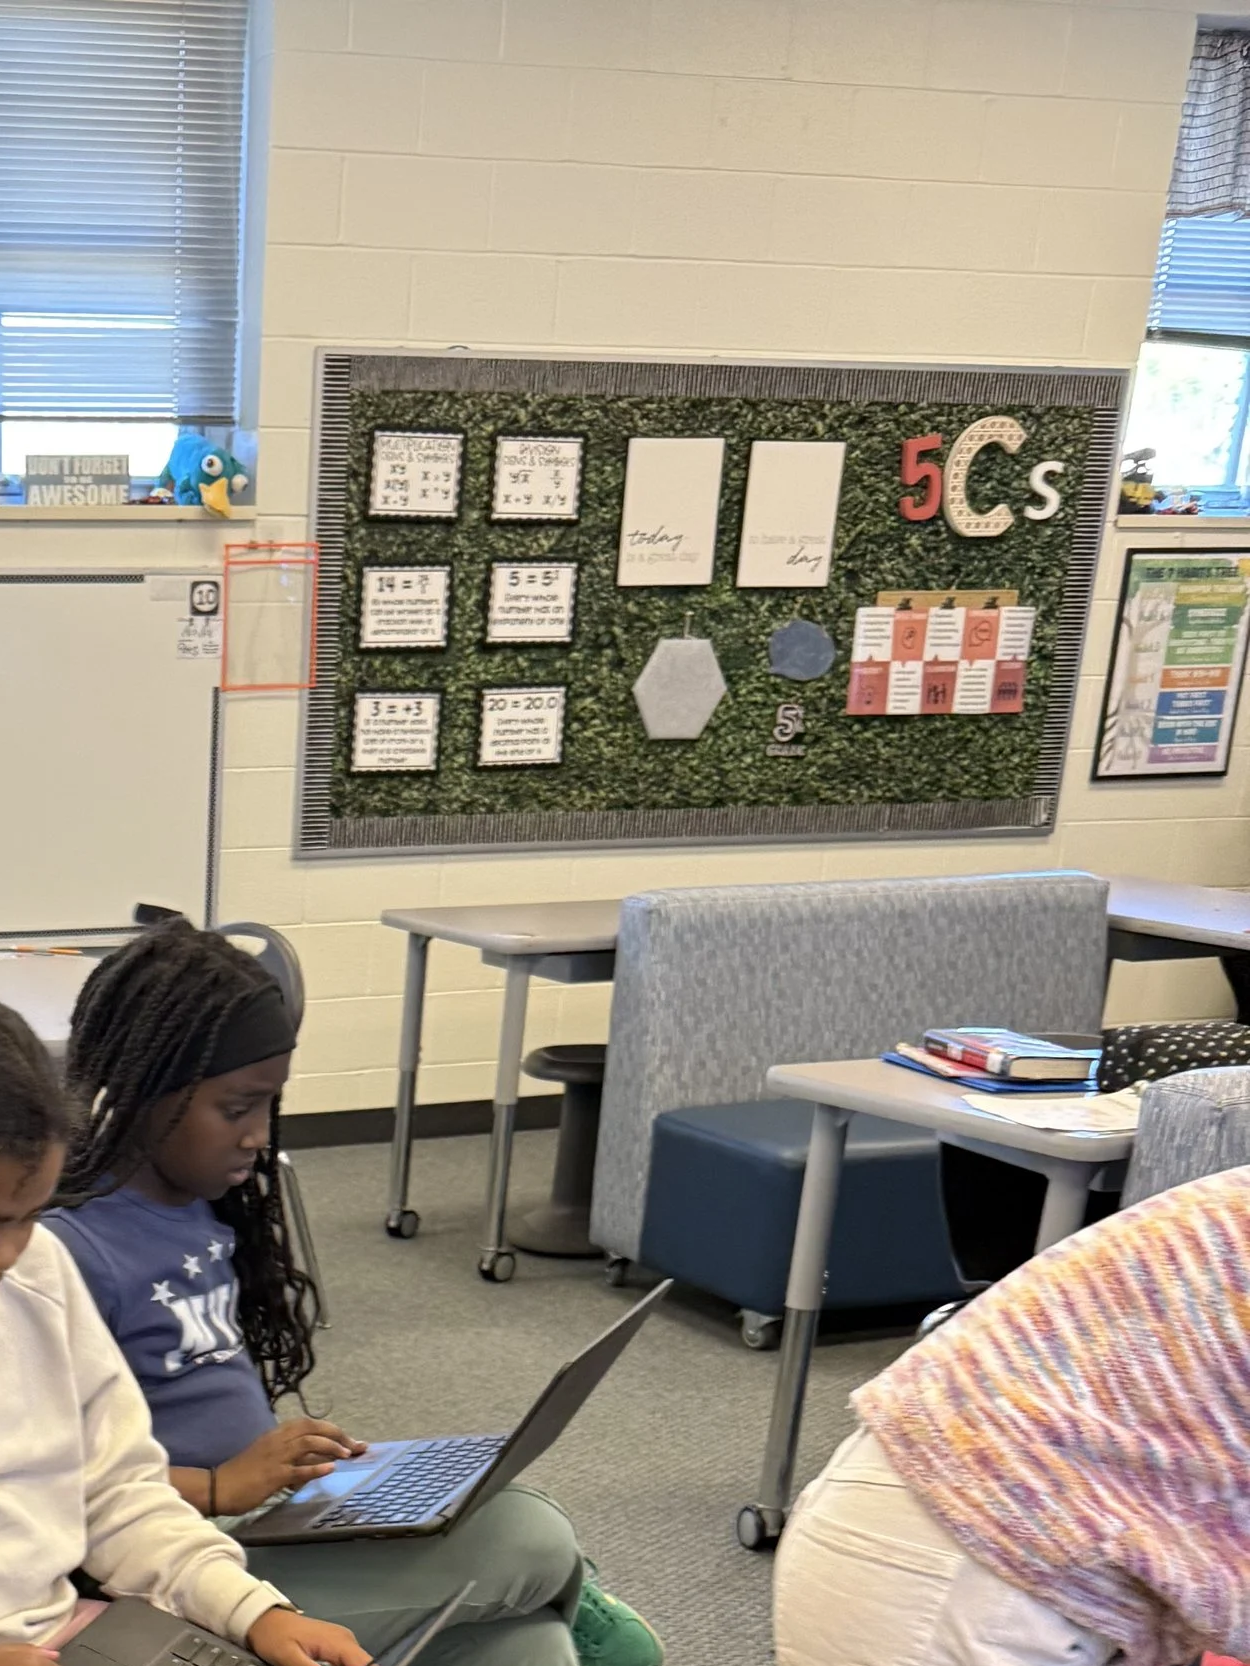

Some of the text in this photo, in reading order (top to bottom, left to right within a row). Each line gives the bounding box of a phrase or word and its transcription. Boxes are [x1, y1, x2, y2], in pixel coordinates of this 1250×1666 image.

[27, 456, 129, 475] DON'T FORGET
[28, 484, 129, 506] AWESOME
[626, 525, 684, 552] today
[786, 545, 823, 573] day
[508, 571, 520, 587] 5
[197, 589, 217, 606] 10
[370, 701, 381, 717] 3
[487, 698, 508, 711] 20
[523, 696, 558, 711] 20.0
